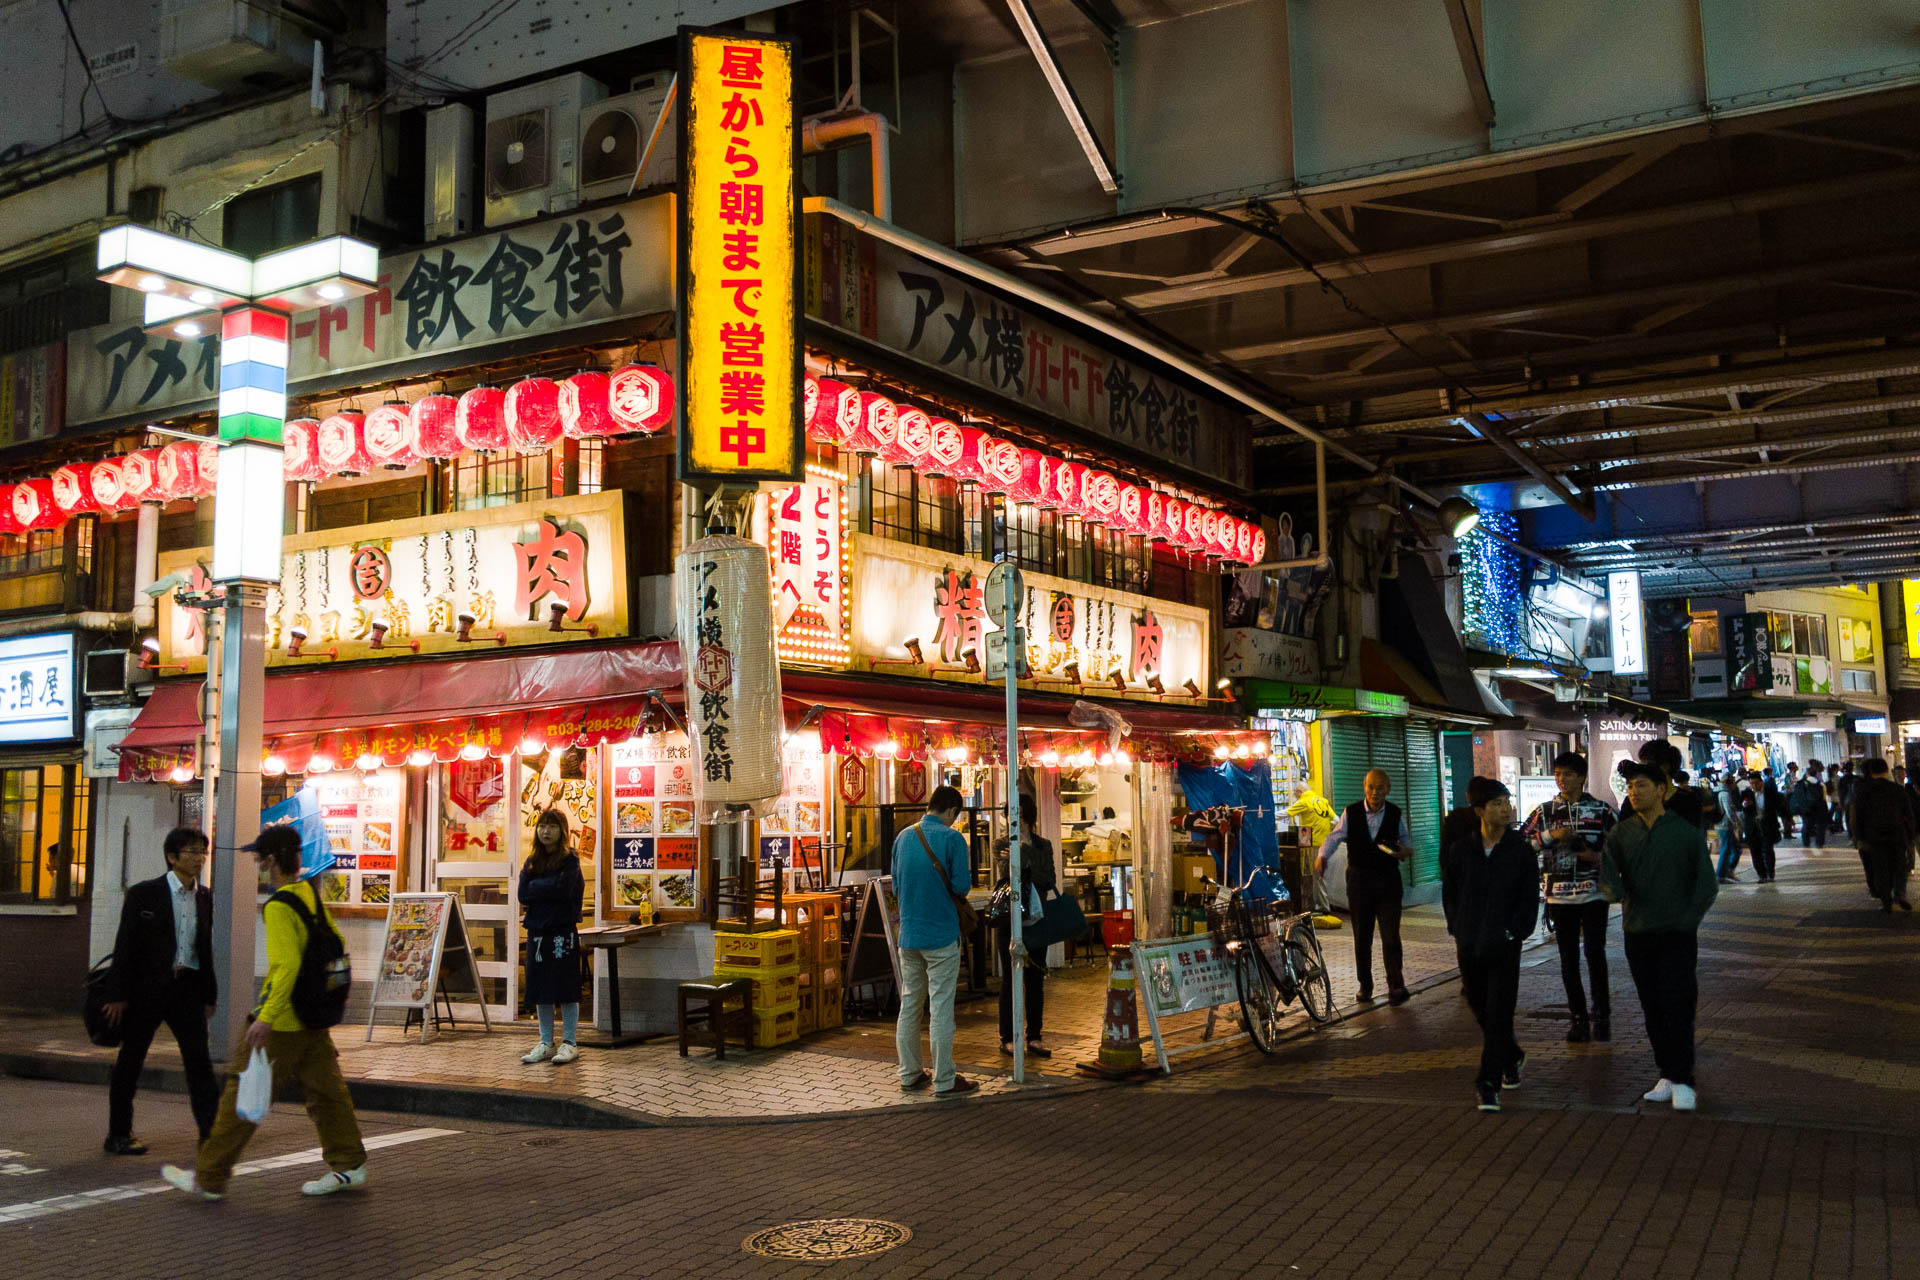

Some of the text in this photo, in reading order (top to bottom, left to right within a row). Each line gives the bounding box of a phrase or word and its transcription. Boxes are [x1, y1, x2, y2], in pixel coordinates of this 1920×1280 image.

[718, 45, 766, 466] 昼から朝まで営業中
[897, 271, 1199, 465] アメ横ガード下飲食街
[512, 520, 588, 622] 肉
[814, 486, 833, 603] どうぞ
[692, 561, 722, 647] アメ横
[1135, 611, 1163, 678] 肉
[0, 667, 64, 710] 酒屋
[699, 691, 734, 783] 飲食街
[1178, 947, 1236, 966] 駐輪禁
